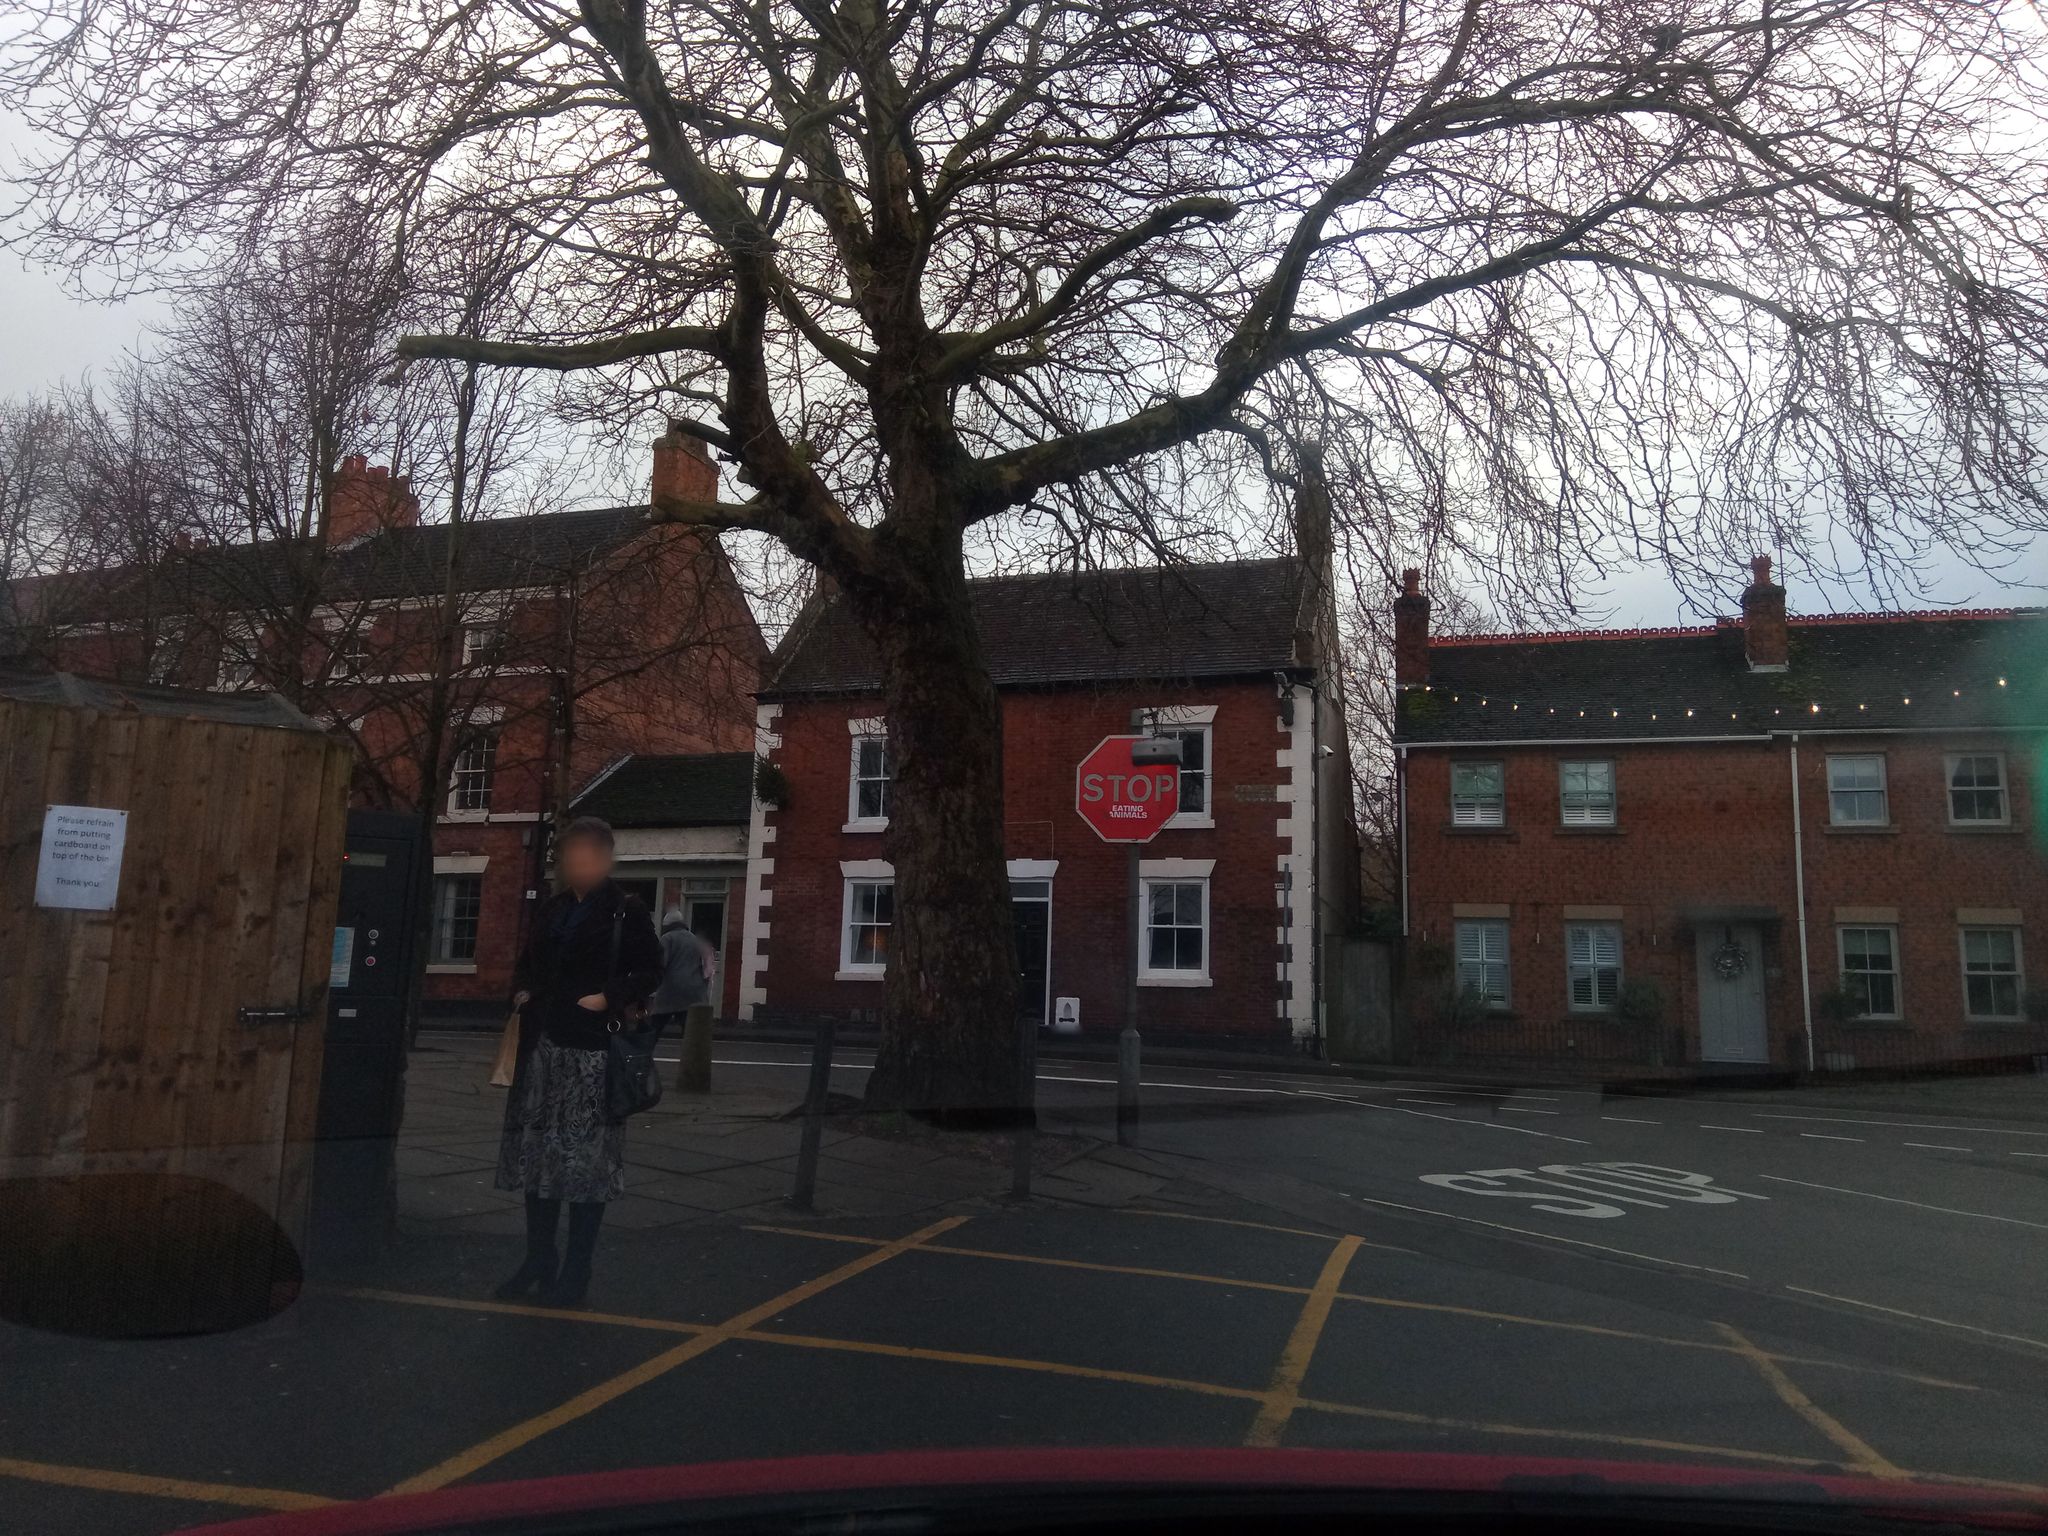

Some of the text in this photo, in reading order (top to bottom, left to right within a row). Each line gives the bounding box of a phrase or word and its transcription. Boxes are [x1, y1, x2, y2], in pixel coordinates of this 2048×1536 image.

[1082, 774, 1175, 802] STOP
[1112, 804, 1144, 812] EATING
[1109, 811, 1148, 819] ANIMALS
[57, 816, 114, 828] Please refrain
[57, 828, 111, 840] from putting
[54, 840, 98, 849] cardboard
[52, 851, 67, 861] top
[68, 852, 79, 860] of
[80, 853, 95, 861] the
[56, 877, 82, 887] Thank
[1418, 1161, 1771, 1219] STOP
